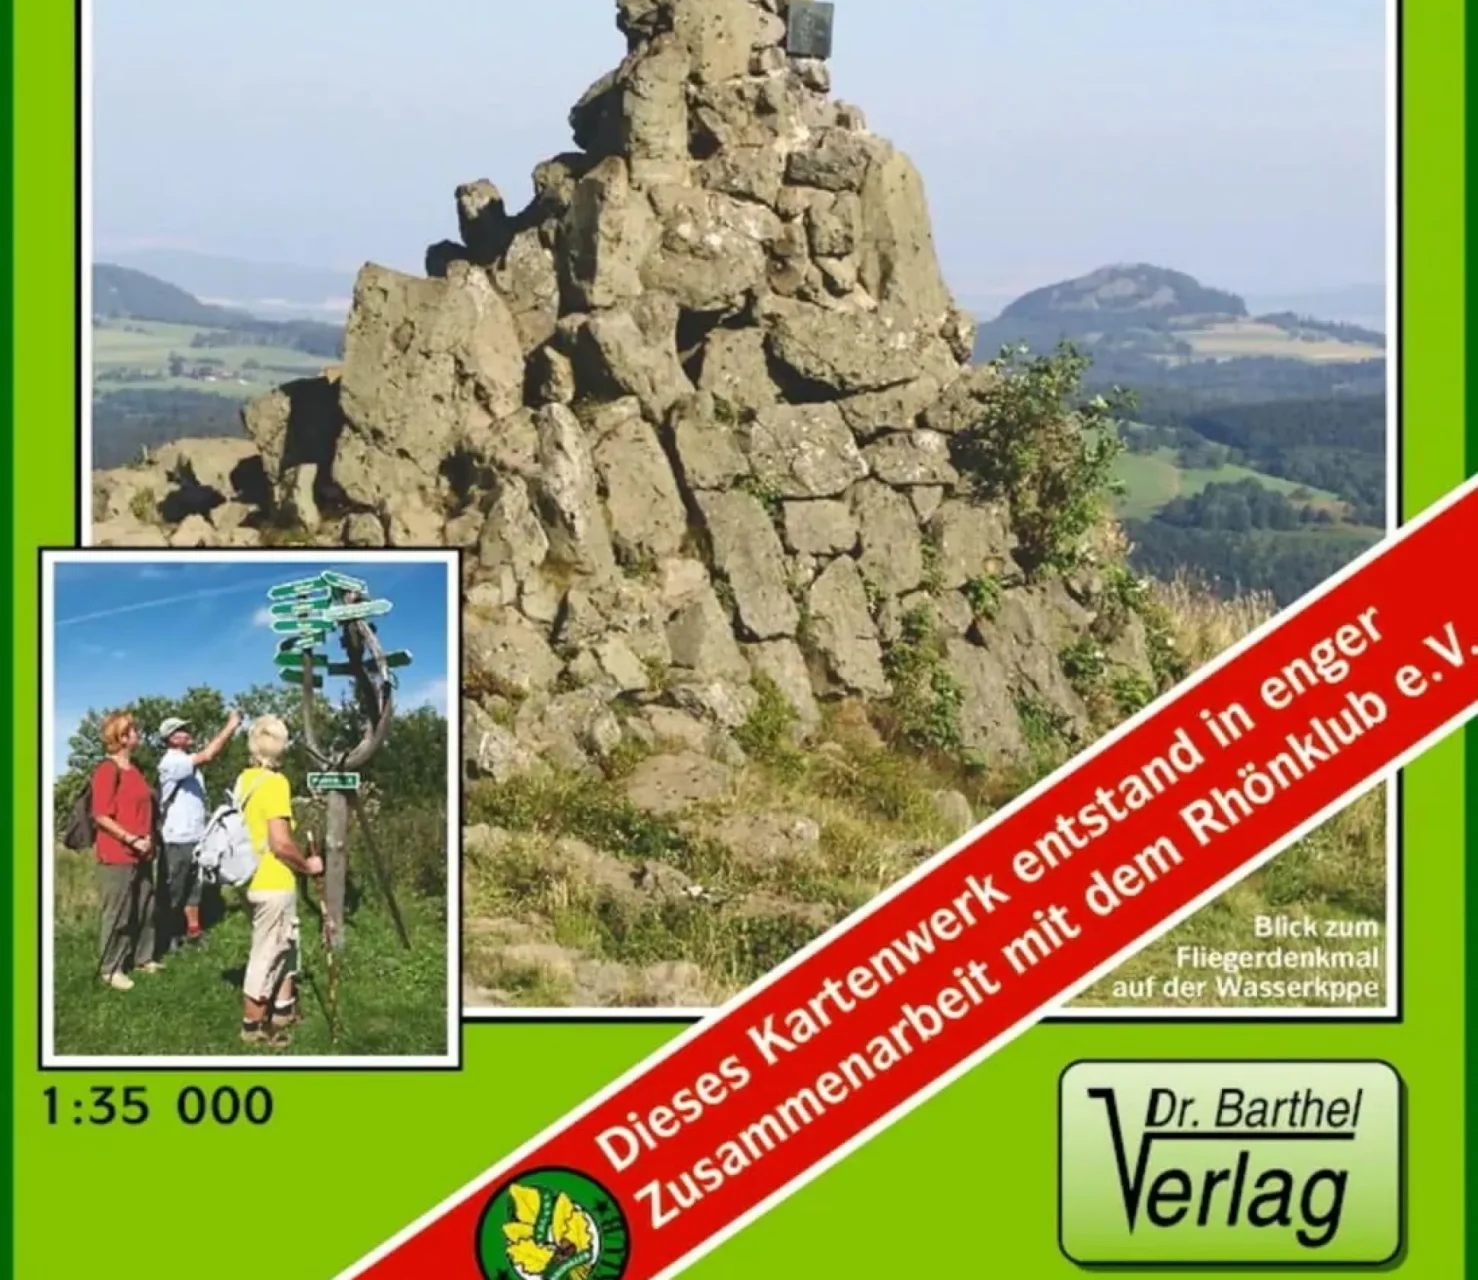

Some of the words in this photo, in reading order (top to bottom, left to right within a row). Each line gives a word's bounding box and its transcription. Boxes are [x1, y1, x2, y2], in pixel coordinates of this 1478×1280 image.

[594, 1055, 751, 1172] Dieses
[746, 875, 1011, 1065] Kartenwerk
[1012, 727, 1205, 883] entstand
[1199, 703, 1255, 747] in
[1260, 606, 1382, 710] enger
[1253, 915, 1318, 939] Blick
[1324, 919, 1380, 939] zum
[633, 960, 1002, 1230] Zusammenarbeit
[1001, 904, 1082, 974] mit
[1085, 836, 1184, 916] dem
[1179, 691, 1388, 846] Rhönklub
[1176, 946, 1380, 974] Fliegerdenkmal
[1112, 976, 1155, 998] auf
[1163, 976, 1207, 998] der
[1214, 976, 1380, 1002] Wasserkppe
[43, 1085, 150, 1125] 1:35
[176, 1085, 274, 1125] 000
[1144, 1088, 1199, 1127] Dr.
[1214, 1088, 1363, 1128] Barthel
[1087, 1087, 1350, 1249] Verlag
